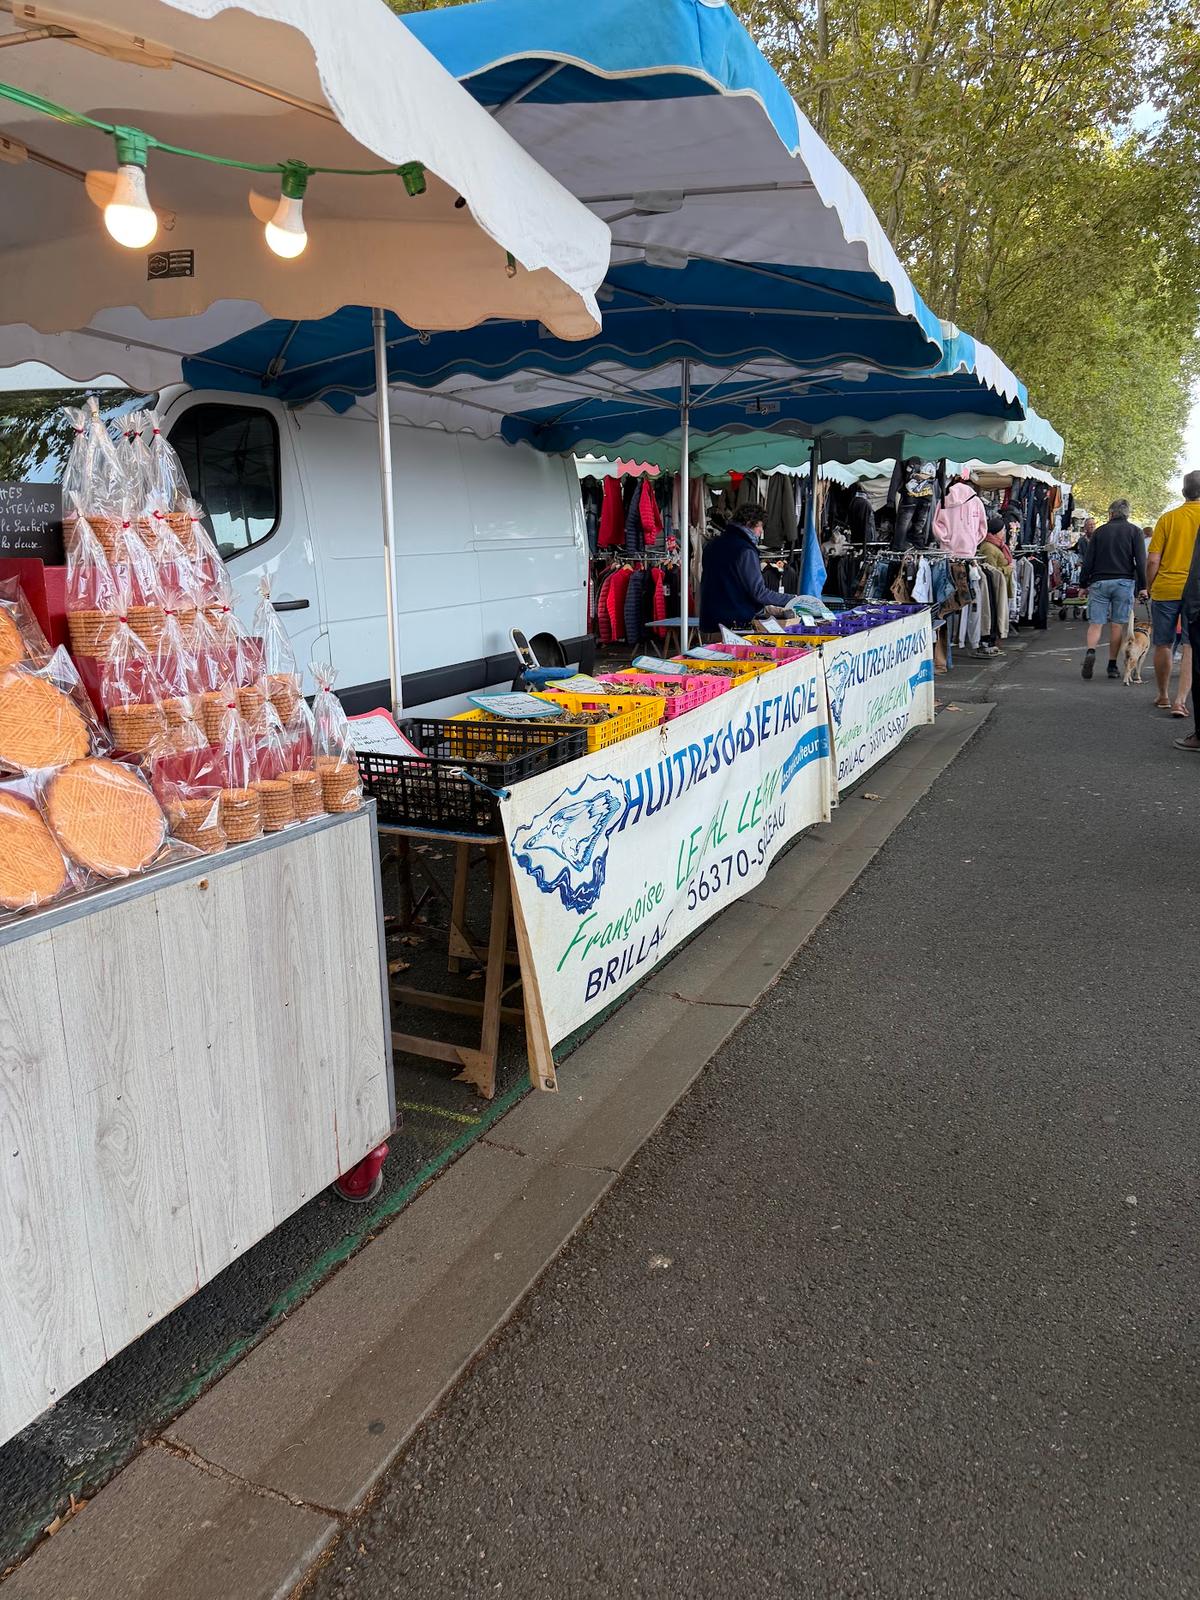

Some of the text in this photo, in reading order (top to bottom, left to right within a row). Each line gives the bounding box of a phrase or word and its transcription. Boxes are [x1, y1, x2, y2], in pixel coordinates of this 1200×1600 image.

[618, 728, 723, 832] HUITRES
[739, 677, 819, 754] BETAGNE
[557, 881, 665, 972] Françoise
[676, 825, 703, 891] LE
